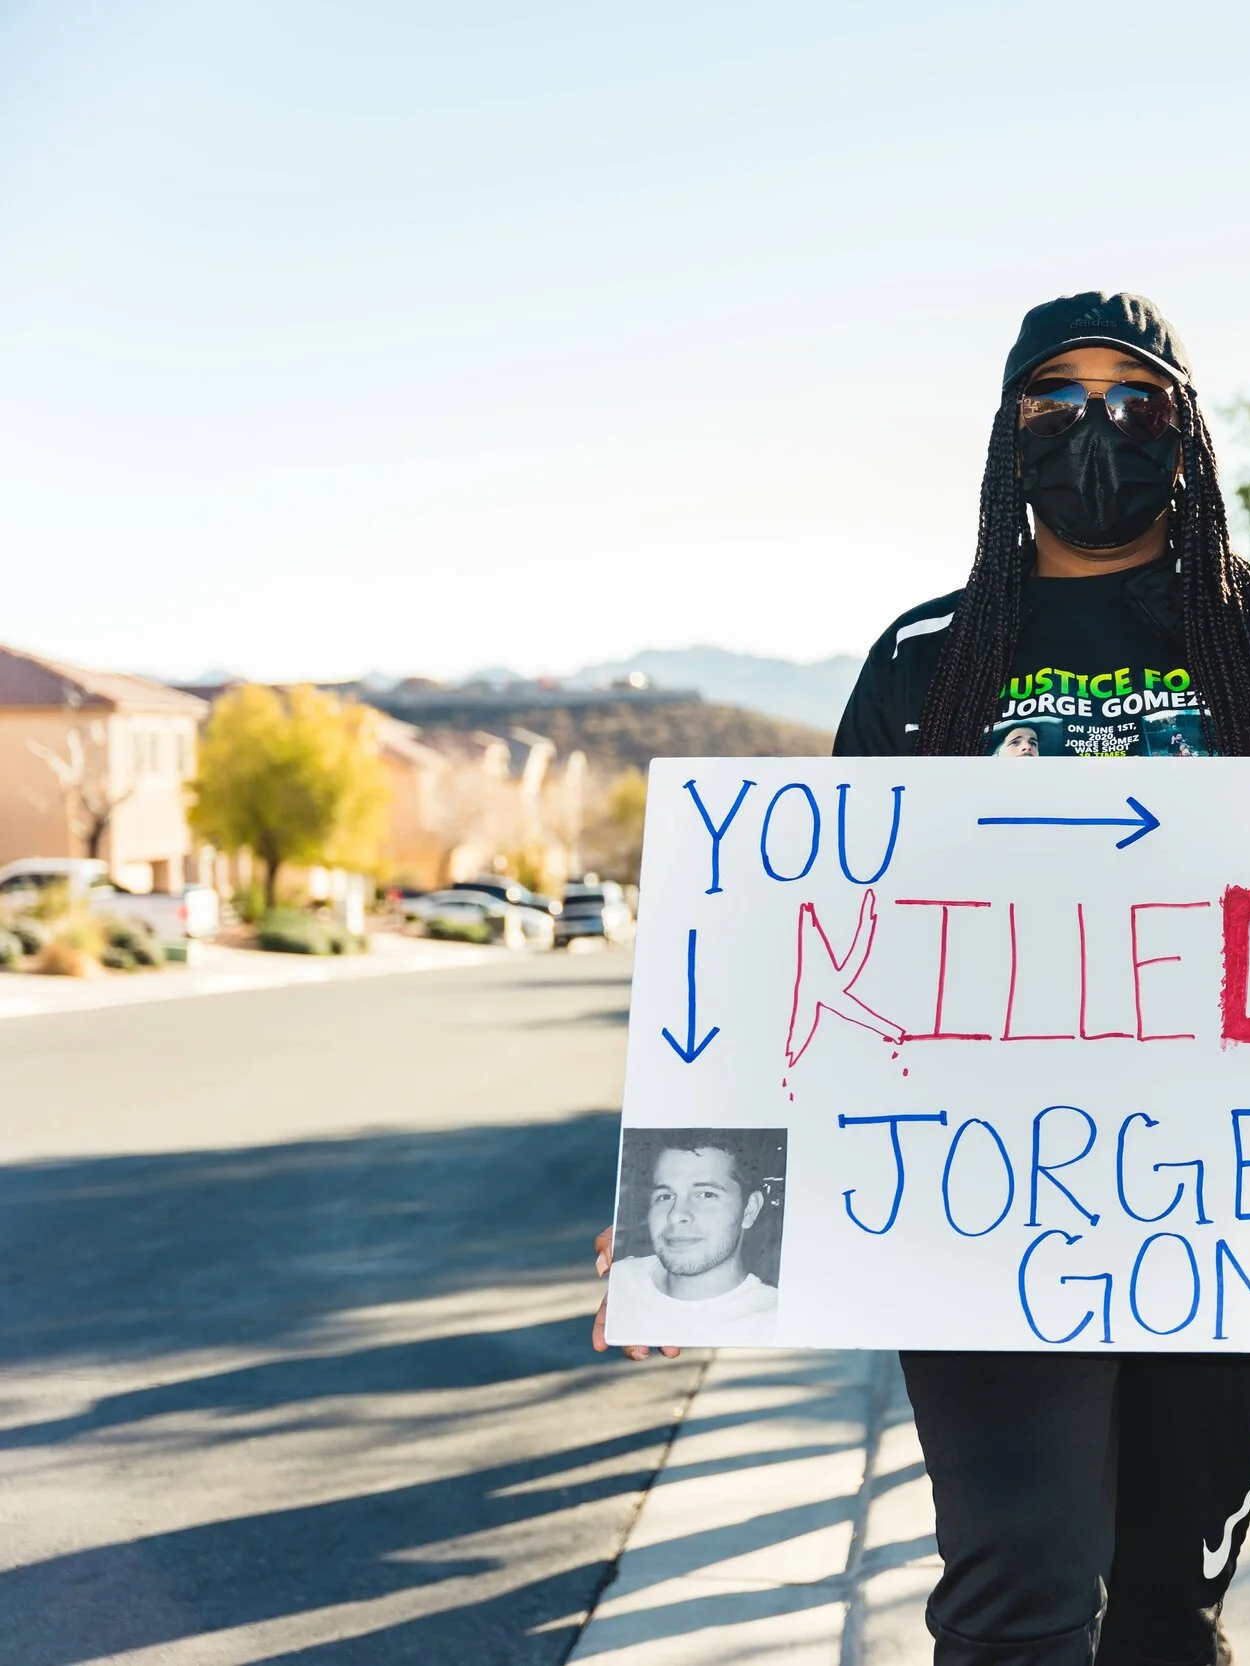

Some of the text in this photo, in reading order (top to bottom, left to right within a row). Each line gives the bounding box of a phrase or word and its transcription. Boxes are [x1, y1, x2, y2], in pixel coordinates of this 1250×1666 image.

[1000, 667, 1190, 699] USTICE FO
[1002, 690, 1205, 718] JORGE GOMEZ
[1067, 722, 1137, 734] ON JUNE 1ST,
[1065, 734, 1140, 748] JORGE GOMEZ
[1088, 733, 1117, 741] 2020,
[1075, 742, 1130, 754] WAS SHOT
[683, 779, 906, 894] YOU
